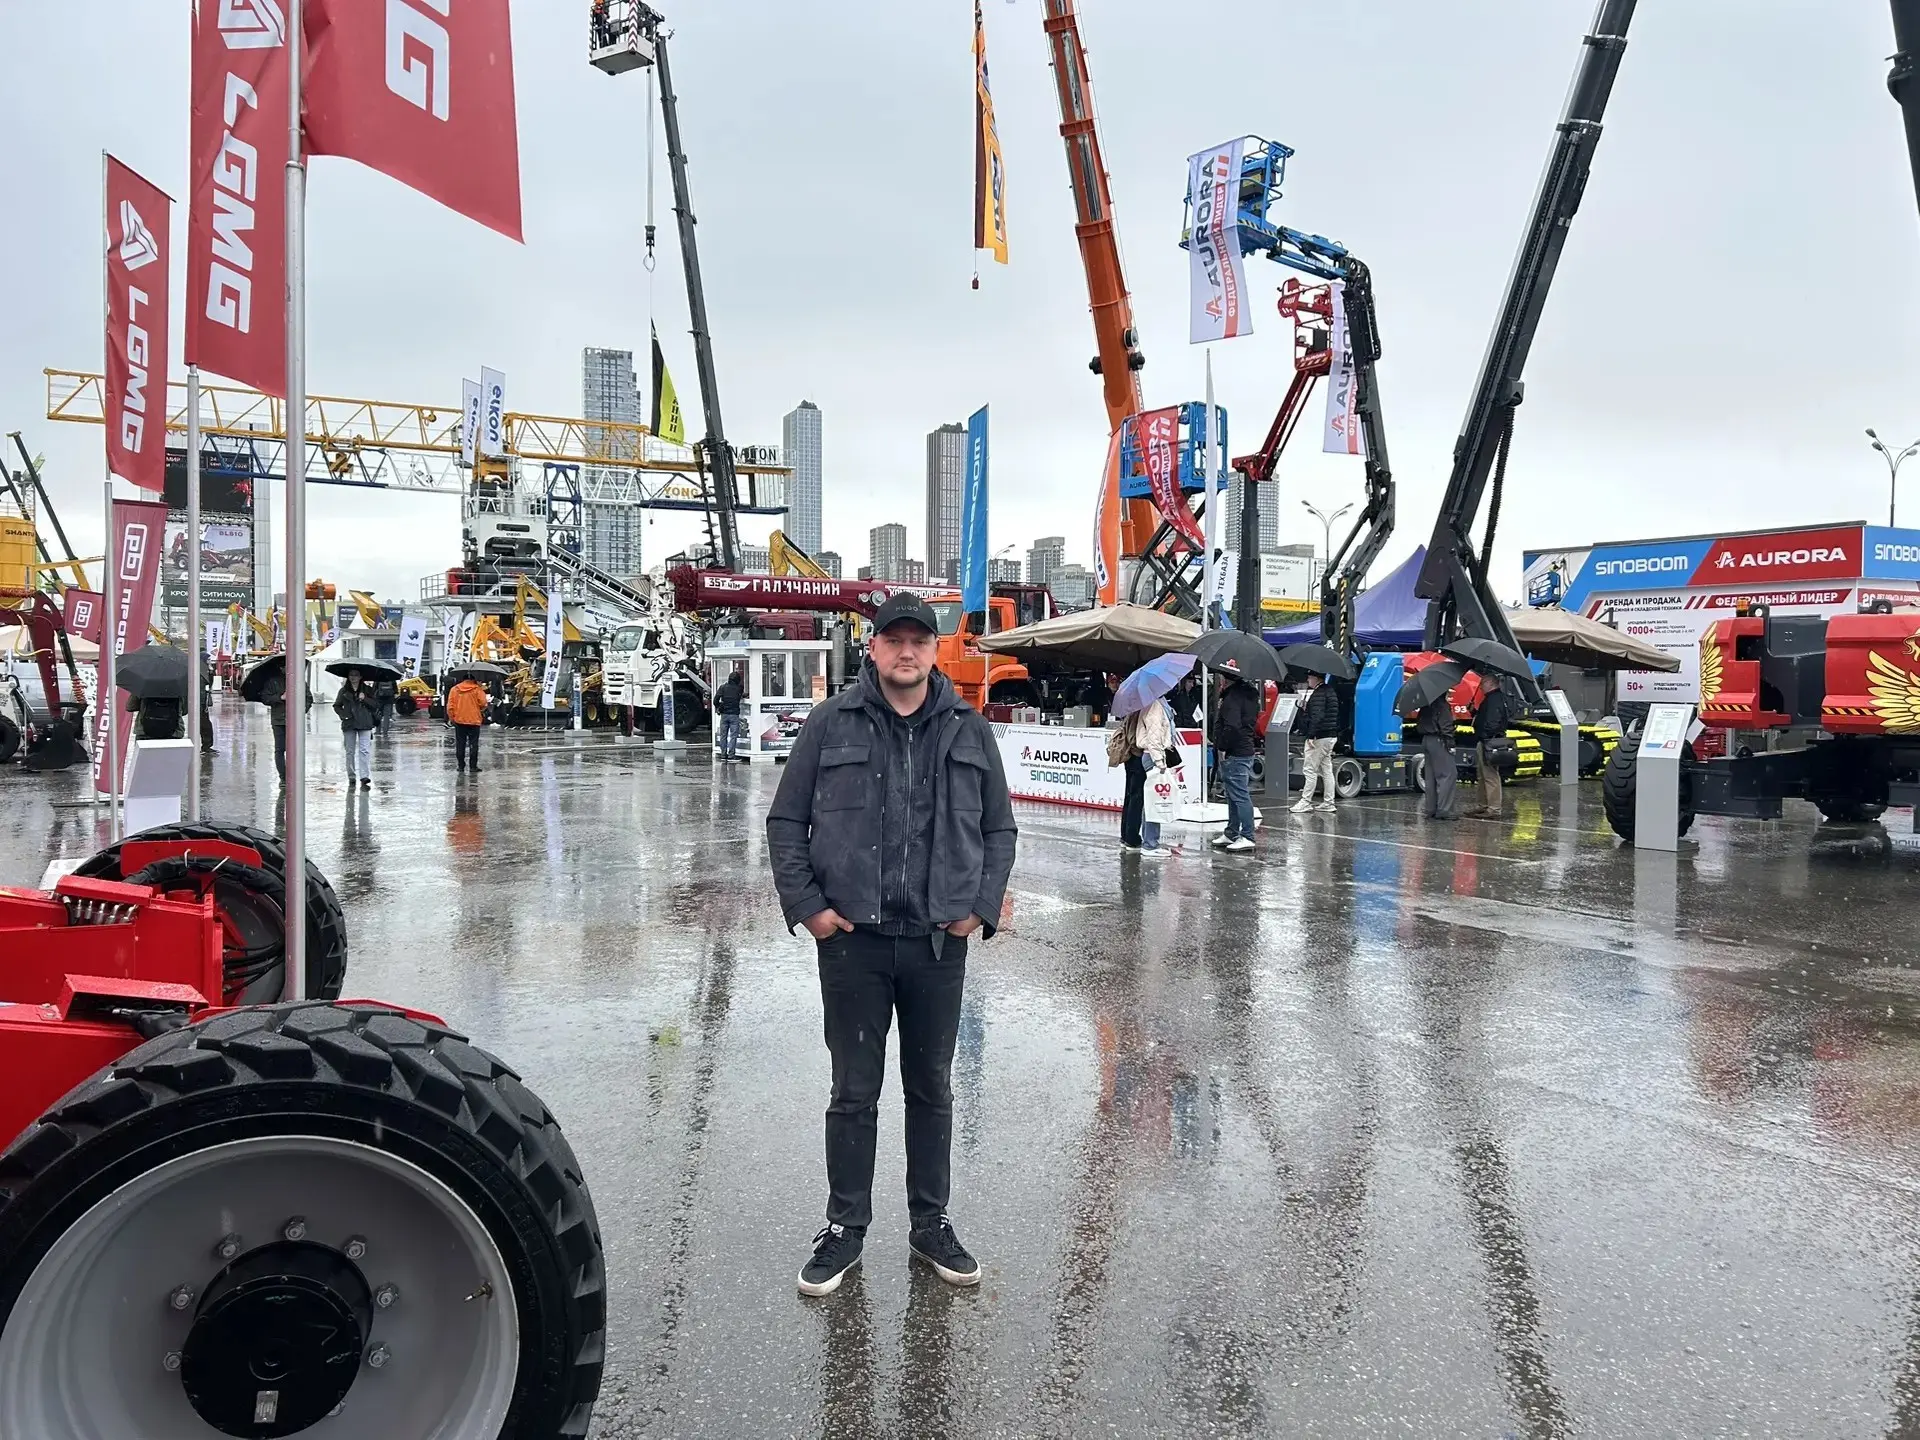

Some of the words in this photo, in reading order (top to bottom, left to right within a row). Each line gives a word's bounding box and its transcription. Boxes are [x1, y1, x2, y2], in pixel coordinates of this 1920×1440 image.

[385, 0, 450, 122] G
[205, 72, 258, 334] LGMG
[1213, 185, 1225, 226] ЛИДЕР
[1195, 156, 1220, 288] AURORA
[1212, 227, 1237, 317] ФЕДЕРАЛЬНЫЙ
[121, 284, 149, 455] LGMG
[1739, 547, 1847, 567] AURORA
[1874, 543, 1920, 563] SINOBO
[1595, 554, 1688, 576] SINOBOOM
[752, 578, 840, 596] ГАЛИЧАНИН
[1642, 597, 1682, 605] ПРОДАЖА
[1799, 592, 1838, 604] ЛИДЕР
[895, 604, 919, 612] HUGO
[1627, 625, 1654, 634] 9000+
[1627, 682, 1643, 690] 50+
[1454, 705, 1467, 714] 93
[1034, 750, 1089, 766] AURORA
[1030, 769, 1081, 786] SINOBOOM
